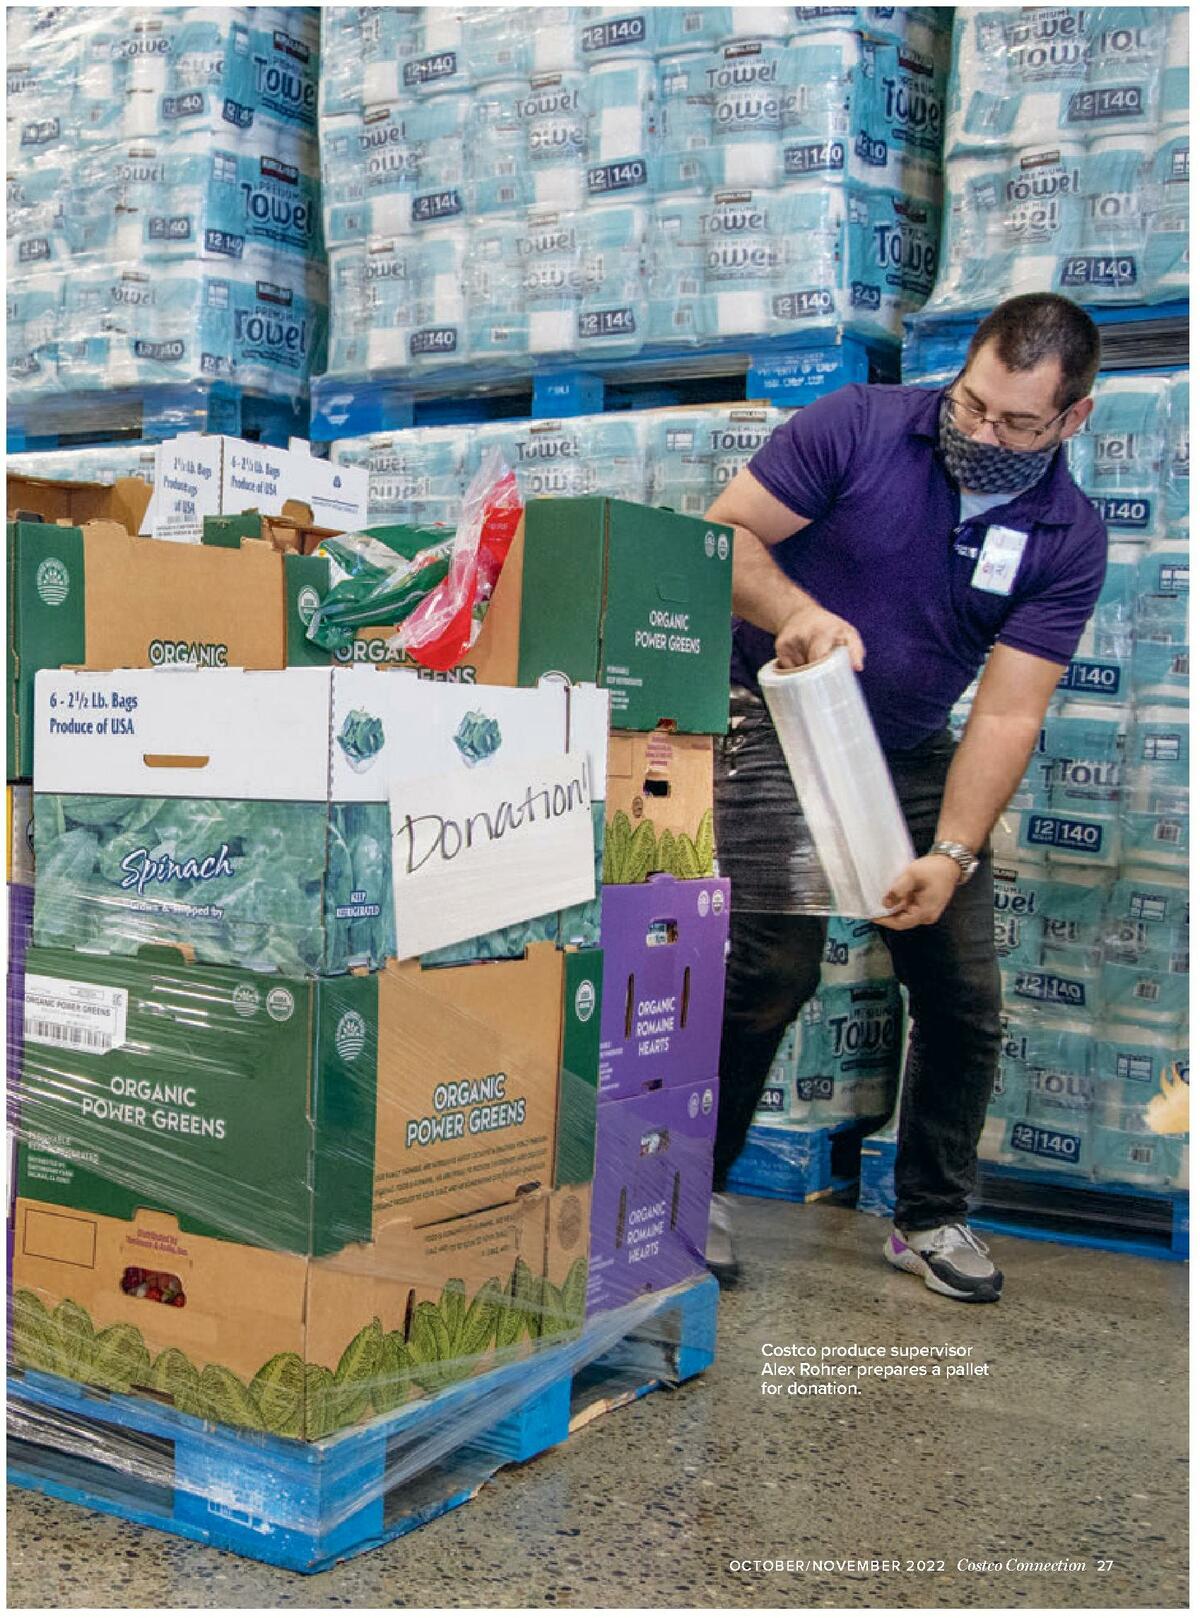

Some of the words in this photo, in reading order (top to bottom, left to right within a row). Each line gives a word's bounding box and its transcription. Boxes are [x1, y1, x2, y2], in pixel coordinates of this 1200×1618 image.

[610, 20, 642, 38] 140
[427, 56, 454, 73] 140
[254, 55, 315, 107] Towe
[706, 62, 777, 89] Towel
[516, 89, 579, 118] Towel
[883, 77, 941, 132] Towe
[1075, 96, 1093, 110] 12
[1103, 91, 1139, 107] 140
[810, 145, 843, 162] 140
[613, 163, 643, 181] 140
[241, 183, 312, 234] Towel
[700, 213, 769, 235] Towel
[516, 229, 576, 256] Towel
[1067, 261, 1087, 276] 12
[1099, 261, 1133, 278] 140
[801, 293, 831, 309] 140
[235, 309, 307, 355] Towel
[264, 482, 277, 496] USA
[1108, 503, 1146, 519] 140
[649, 610, 690, 631] ORGANIC
[334, 638, 417, 664] ORGA
[635, 631, 667, 650] POWER
[668, 635, 701, 654] GREENS
[149, 640, 228, 667] ORGANIC
[418, 666, 477, 685] EENS
[1079, 667, 1115, 685] 140
[92, 692, 108, 709] Lb.
[112, 692, 138, 712] Bags
[50, 718, 93, 735] Produce
[96, 718, 108, 735] of
[111, 718, 135, 735] USA
[397, 762, 591, 874] Donation!
[1034, 819, 1054, 835] 12
[1061, 823, 1097, 843] 140
[120, 844, 234, 896] Spinach
[351, 891, 367, 903] KEEP
[1052, 980, 1081, 998] 140
[83, 1005, 111, 1017] GREENS
[638, 997, 676, 1017] ORGANIC
[636, 1018, 675, 1037] ROMAINE
[639, 1037, 671, 1056] HEARTS
[110, 1077, 196, 1107] ORGANIC
[434, 1073, 507, 1110] ORGANIC
[82, 1099, 146, 1126] POWER
[152, 1110, 226, 1139] GREENS
[406, 1114, 465, 1147] POWER
[469, 1099, 526, 1133] GREENS
[1041, 1135, 1076, 1153] 140
[628, 1202, 666, 1225] ORGANIC
[626, 1222, 665, 1245] ROMAINE
[628, 1241, 659, 1264] HEARTS
